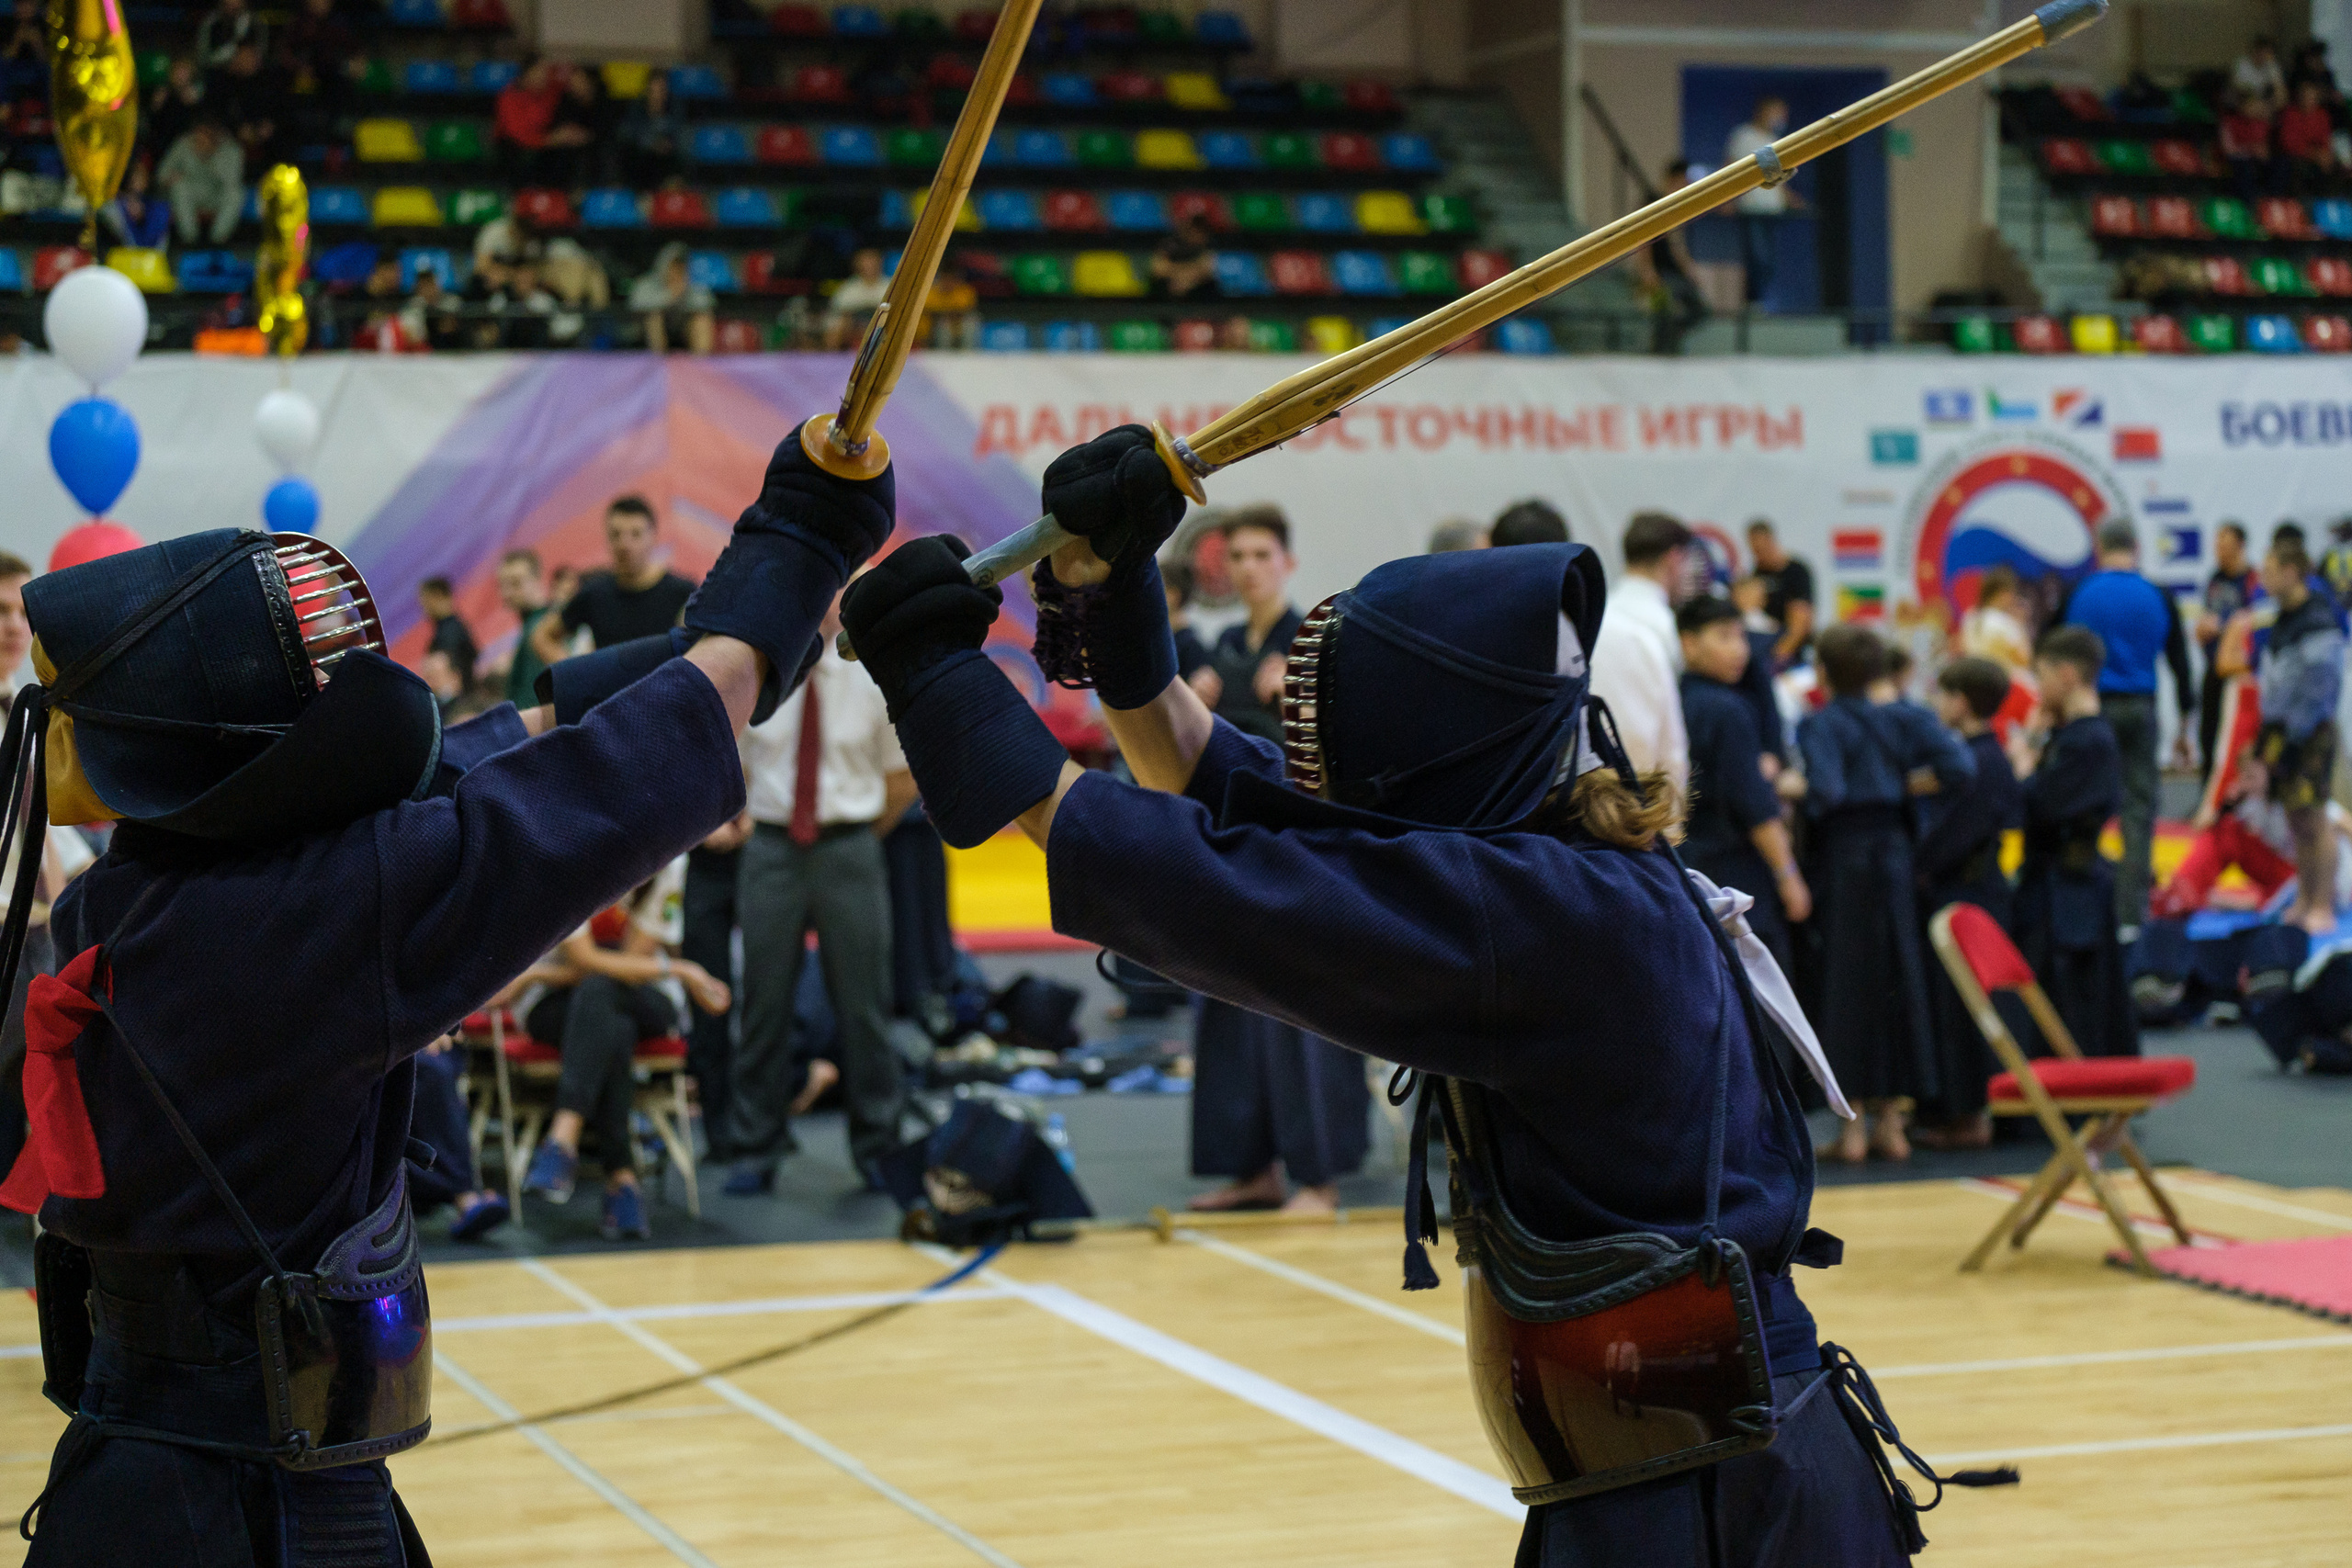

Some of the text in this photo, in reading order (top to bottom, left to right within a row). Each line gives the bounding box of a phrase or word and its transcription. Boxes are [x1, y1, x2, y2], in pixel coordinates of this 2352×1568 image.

[975, 401, 1626, 457] ДАЛНСТОЧНЫЕ
[1639, 401, 1804, 452] ИГРЫ
[2220, 400, 2352, 448] БОЕВ
